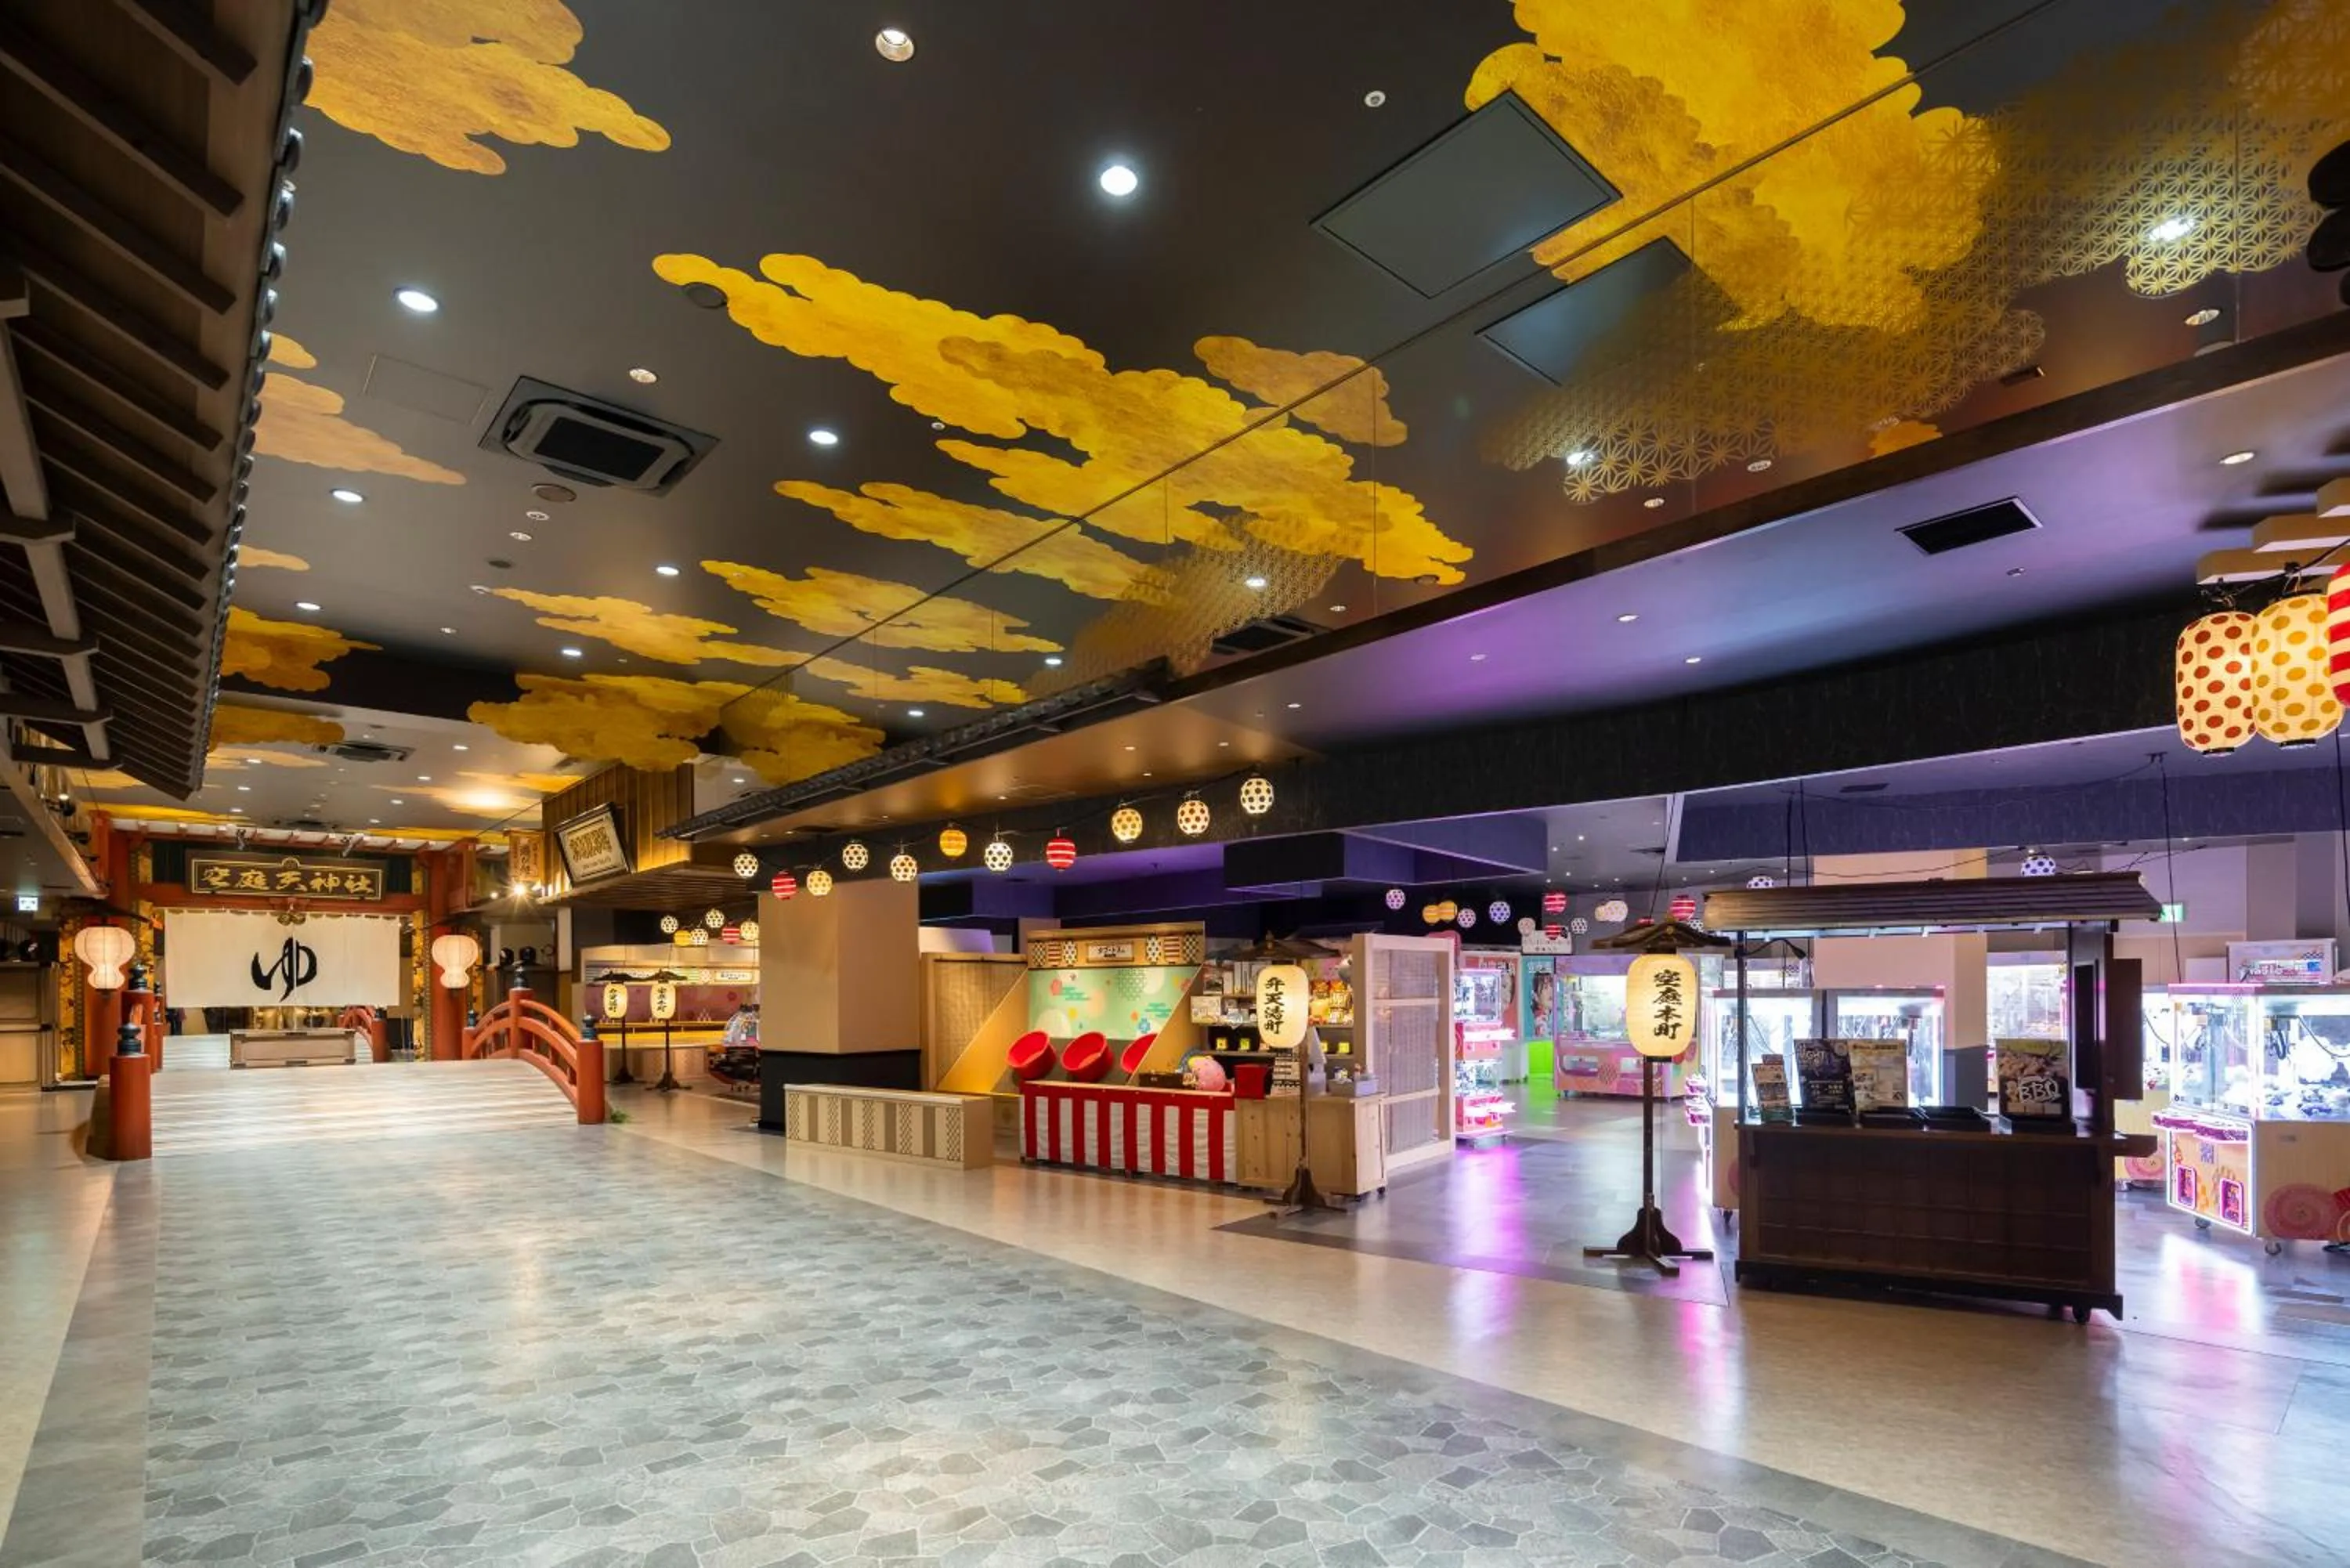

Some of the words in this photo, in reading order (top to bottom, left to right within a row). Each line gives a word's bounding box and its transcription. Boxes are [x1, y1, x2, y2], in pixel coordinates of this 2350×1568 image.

[251, 936, 317, 1003] ゆ
[1653, 969, 1683, 1040] 空庭本町
[2019, 1076, 2062, 1103] BBQ
